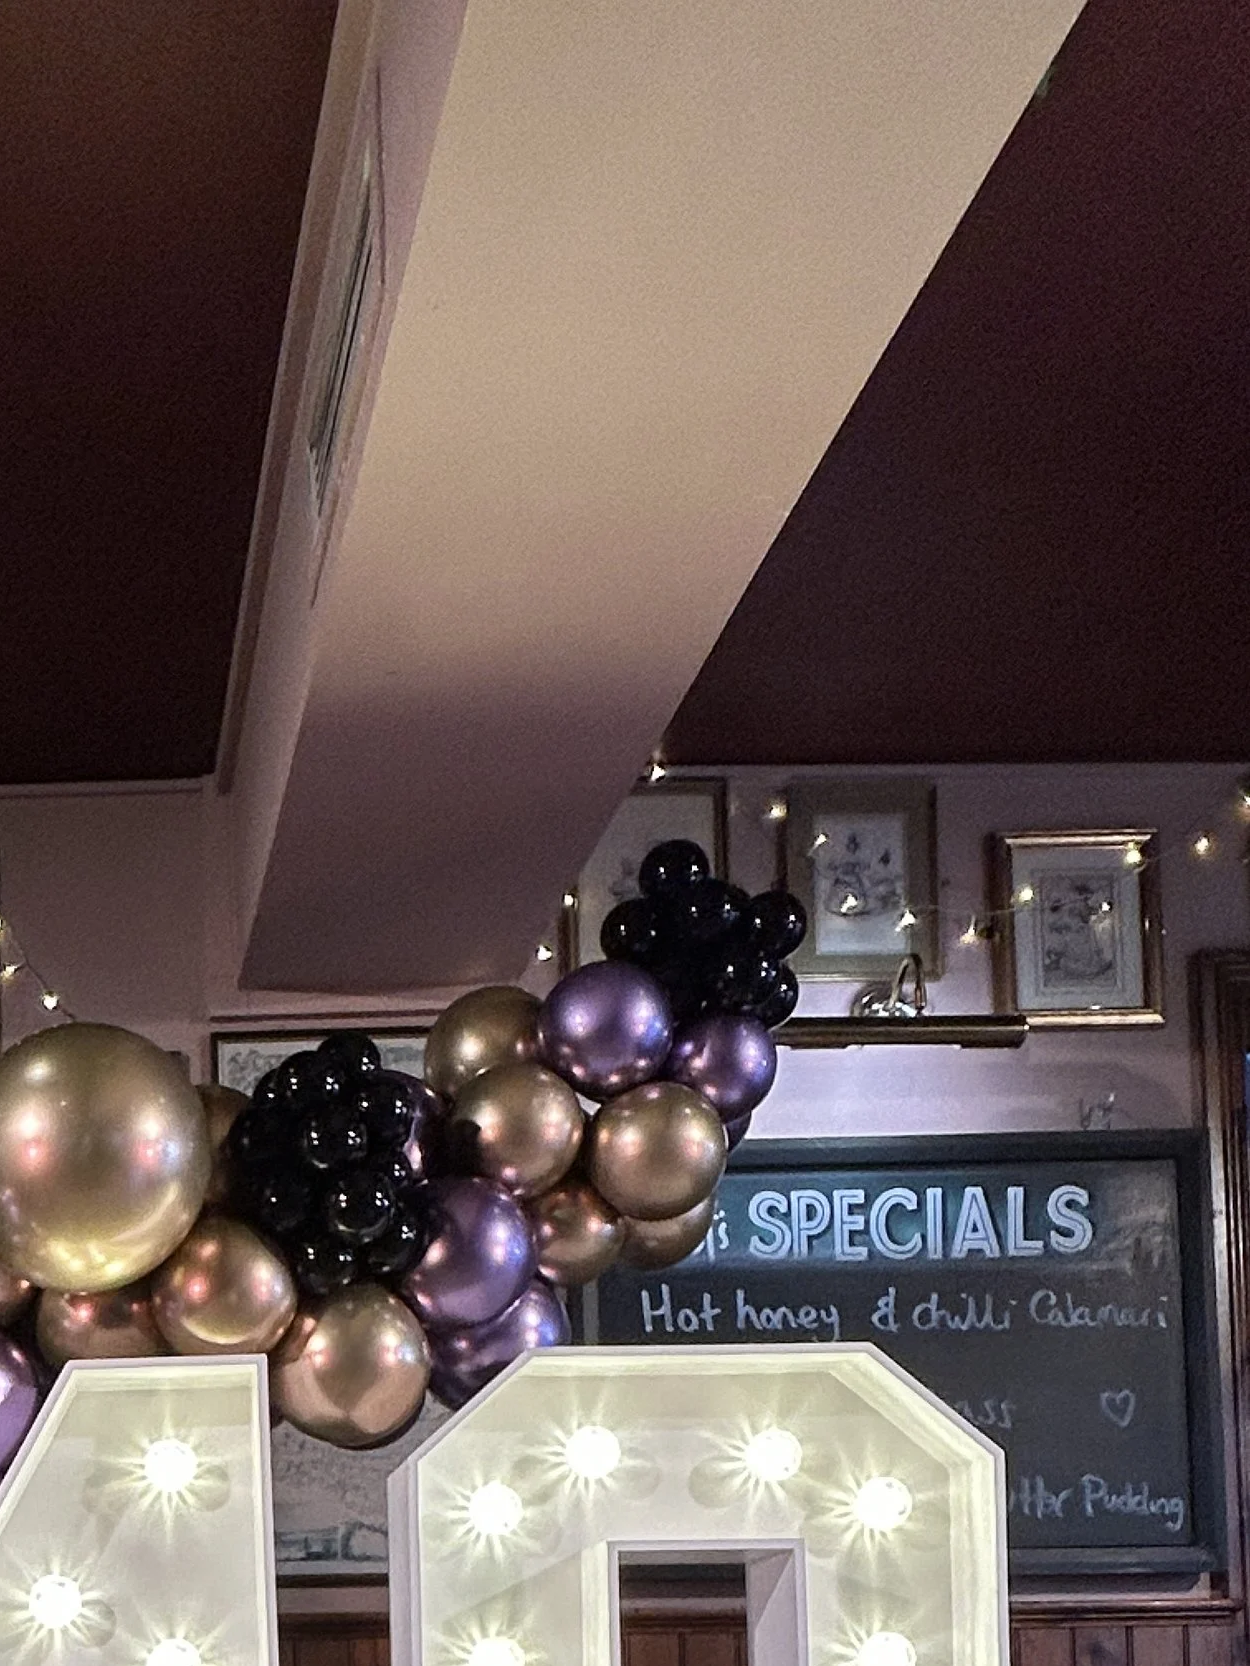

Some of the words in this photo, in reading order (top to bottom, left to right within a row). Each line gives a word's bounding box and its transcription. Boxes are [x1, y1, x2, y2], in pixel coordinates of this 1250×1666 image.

[748, 1184, 1093, 1261] SPECIALS
[641, 1283, 721, 1333] Hot
[735, 1288, 840, 1341] honey
[871, 1286, 899, 1333] &
[912, 1291, 1017, 1331] chilli
[1028, 1289, 1168, 1329] Calamari
[953, 1398, 1014, 1429] ass
[1080, 1473, 1184, 1533] Pudding
